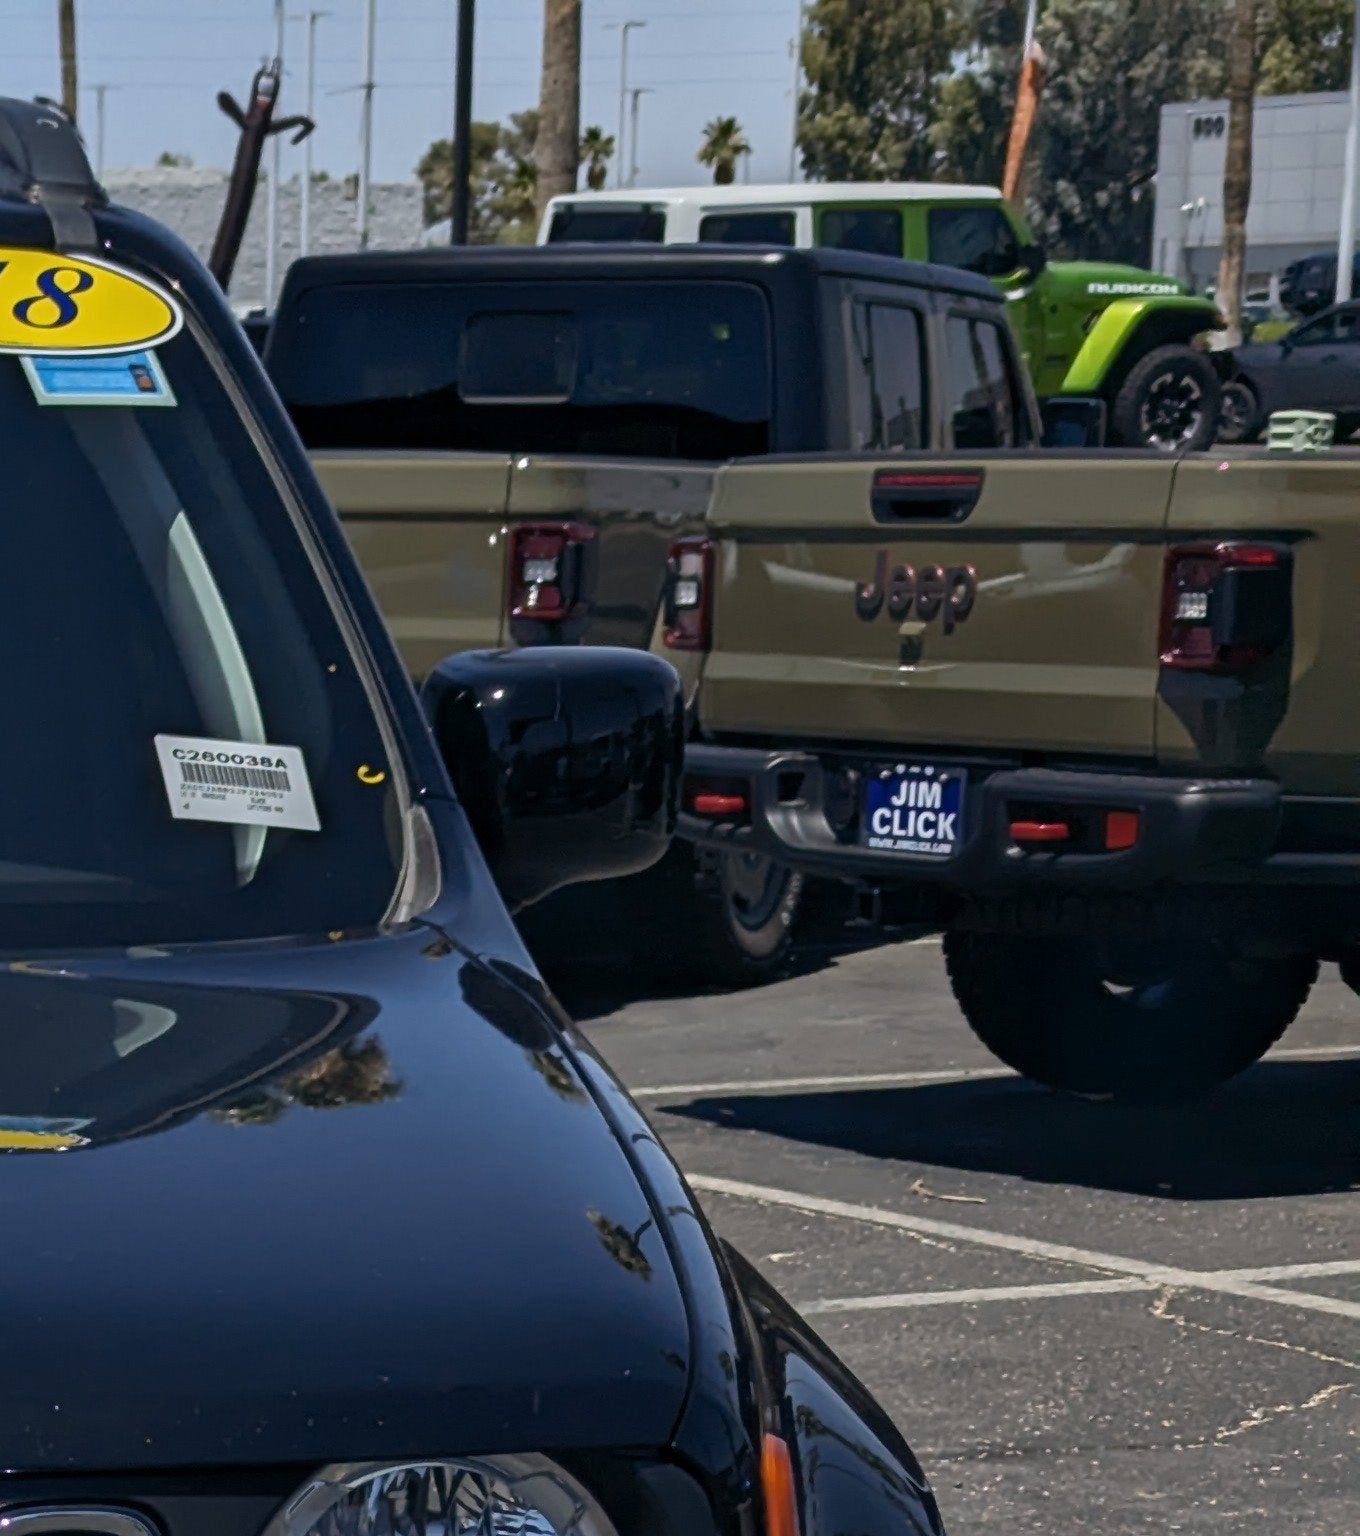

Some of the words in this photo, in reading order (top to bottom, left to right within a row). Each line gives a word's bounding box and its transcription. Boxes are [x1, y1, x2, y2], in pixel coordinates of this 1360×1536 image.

[855, 549, 977, 636] Jeep
[891, 780, 942, 809] JIM
[872, 806, 956, 840] CLICK
